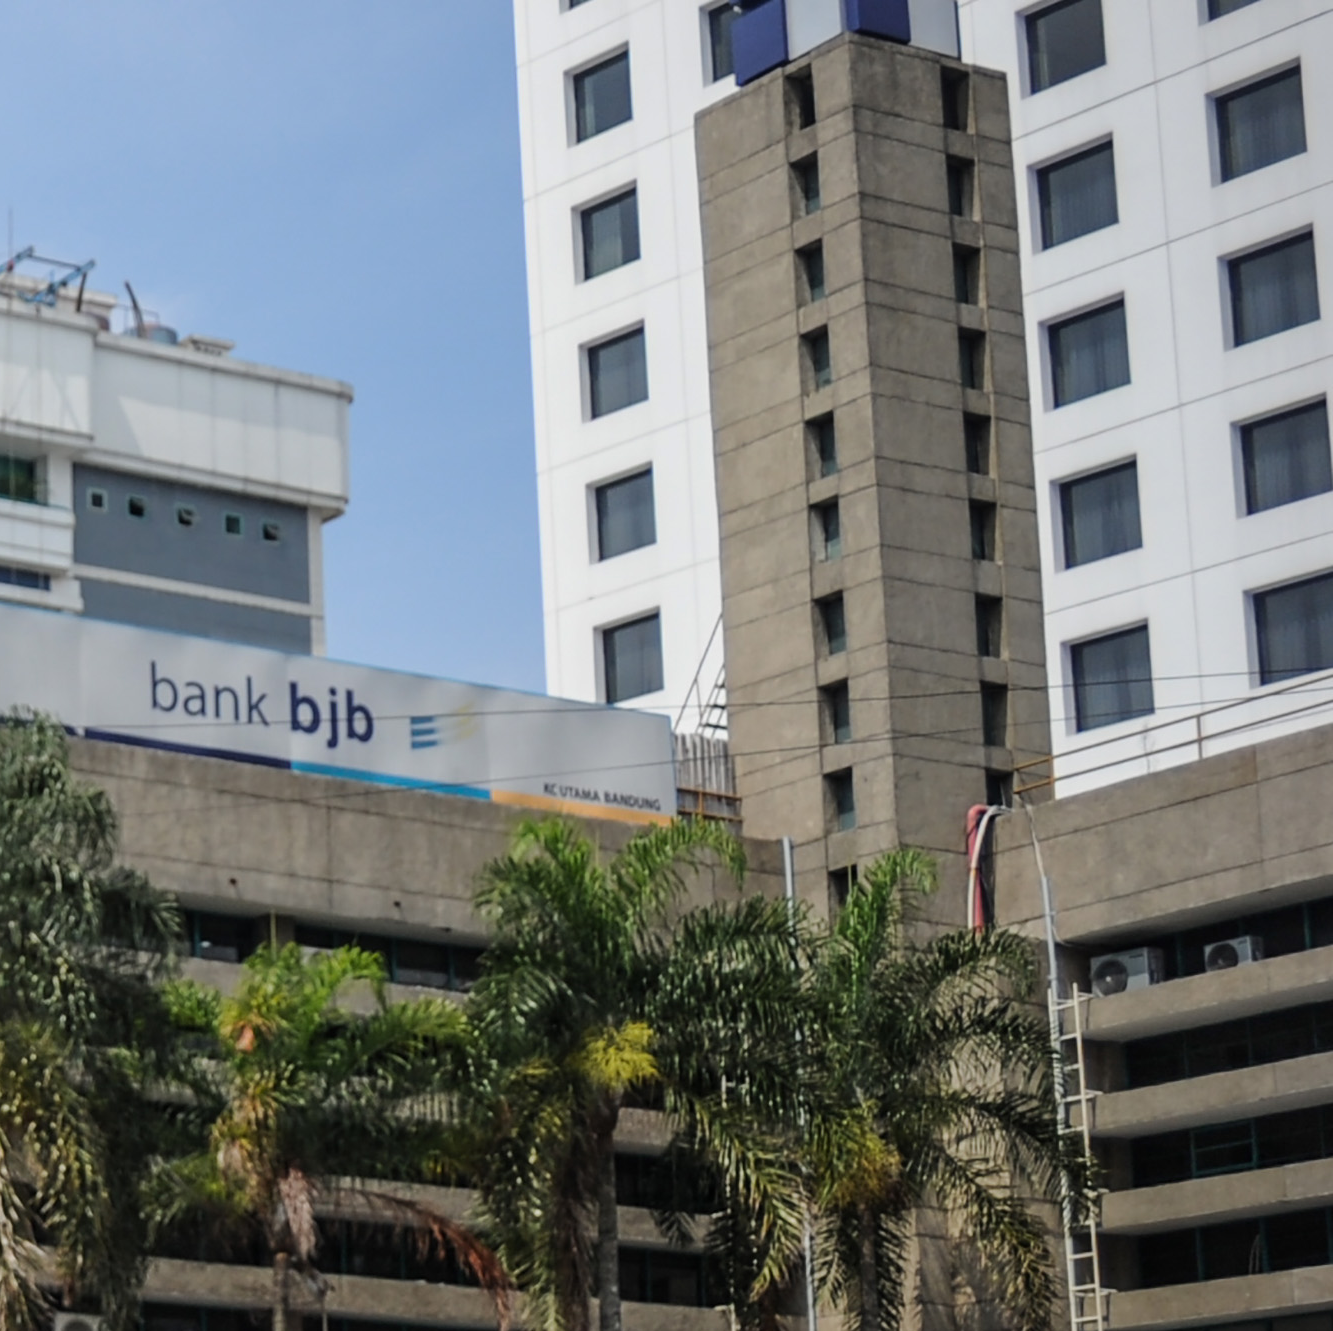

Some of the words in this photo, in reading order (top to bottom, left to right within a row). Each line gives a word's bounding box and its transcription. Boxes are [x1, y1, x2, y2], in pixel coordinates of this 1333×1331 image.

[149, 660, 271, 729] bank
[289, 681, 374, 750] bjb
[559, 785, 600, 803] UTAMA
[604, 790, 662, 812] BANDUNG
